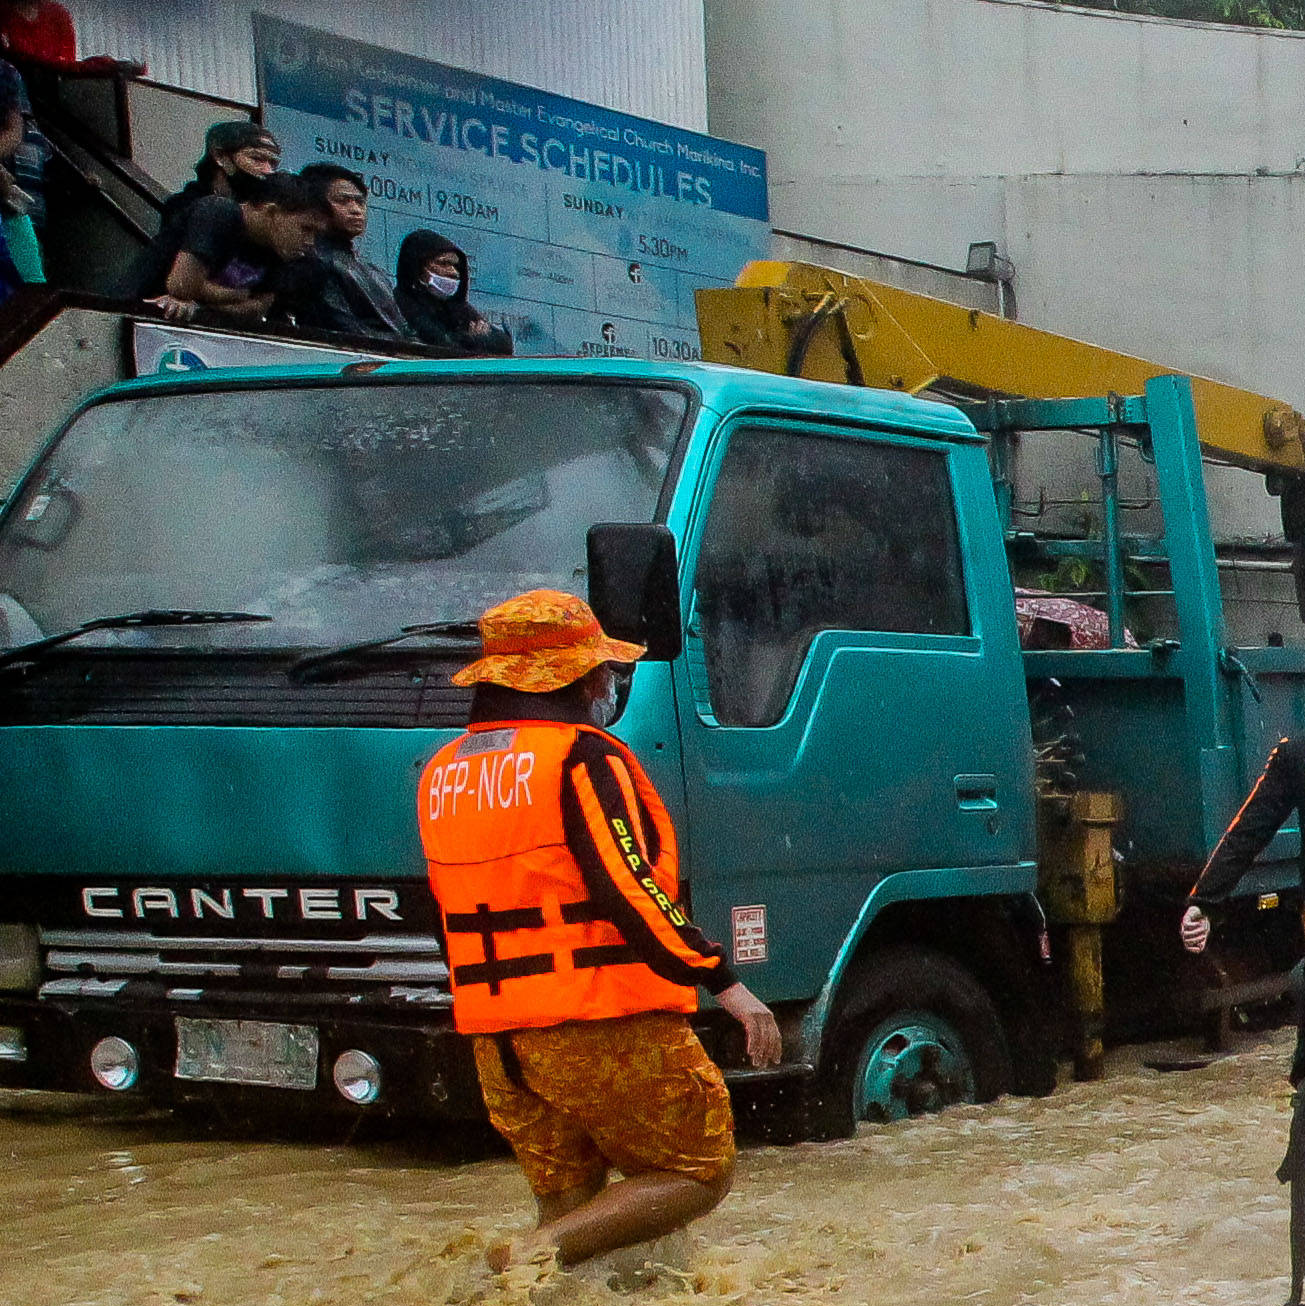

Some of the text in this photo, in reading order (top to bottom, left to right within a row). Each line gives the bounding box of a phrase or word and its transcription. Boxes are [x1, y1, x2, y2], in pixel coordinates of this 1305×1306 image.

[314, 136, 391, 166] SUNDAY
[345, 89, 712, 209] SERVICE SCHEDULES
[445, 86, 476, 106] and
[538, 105, 620, 142] Evangelical
[624, 128, 674, 154] Church
[563, 193, 625, 218] SUNDAY
[429, 752, 536, 820] BFP-NCR
[82, 887, 403, 920] CANTER
[611, 818, 686, 926] BFP SRU
